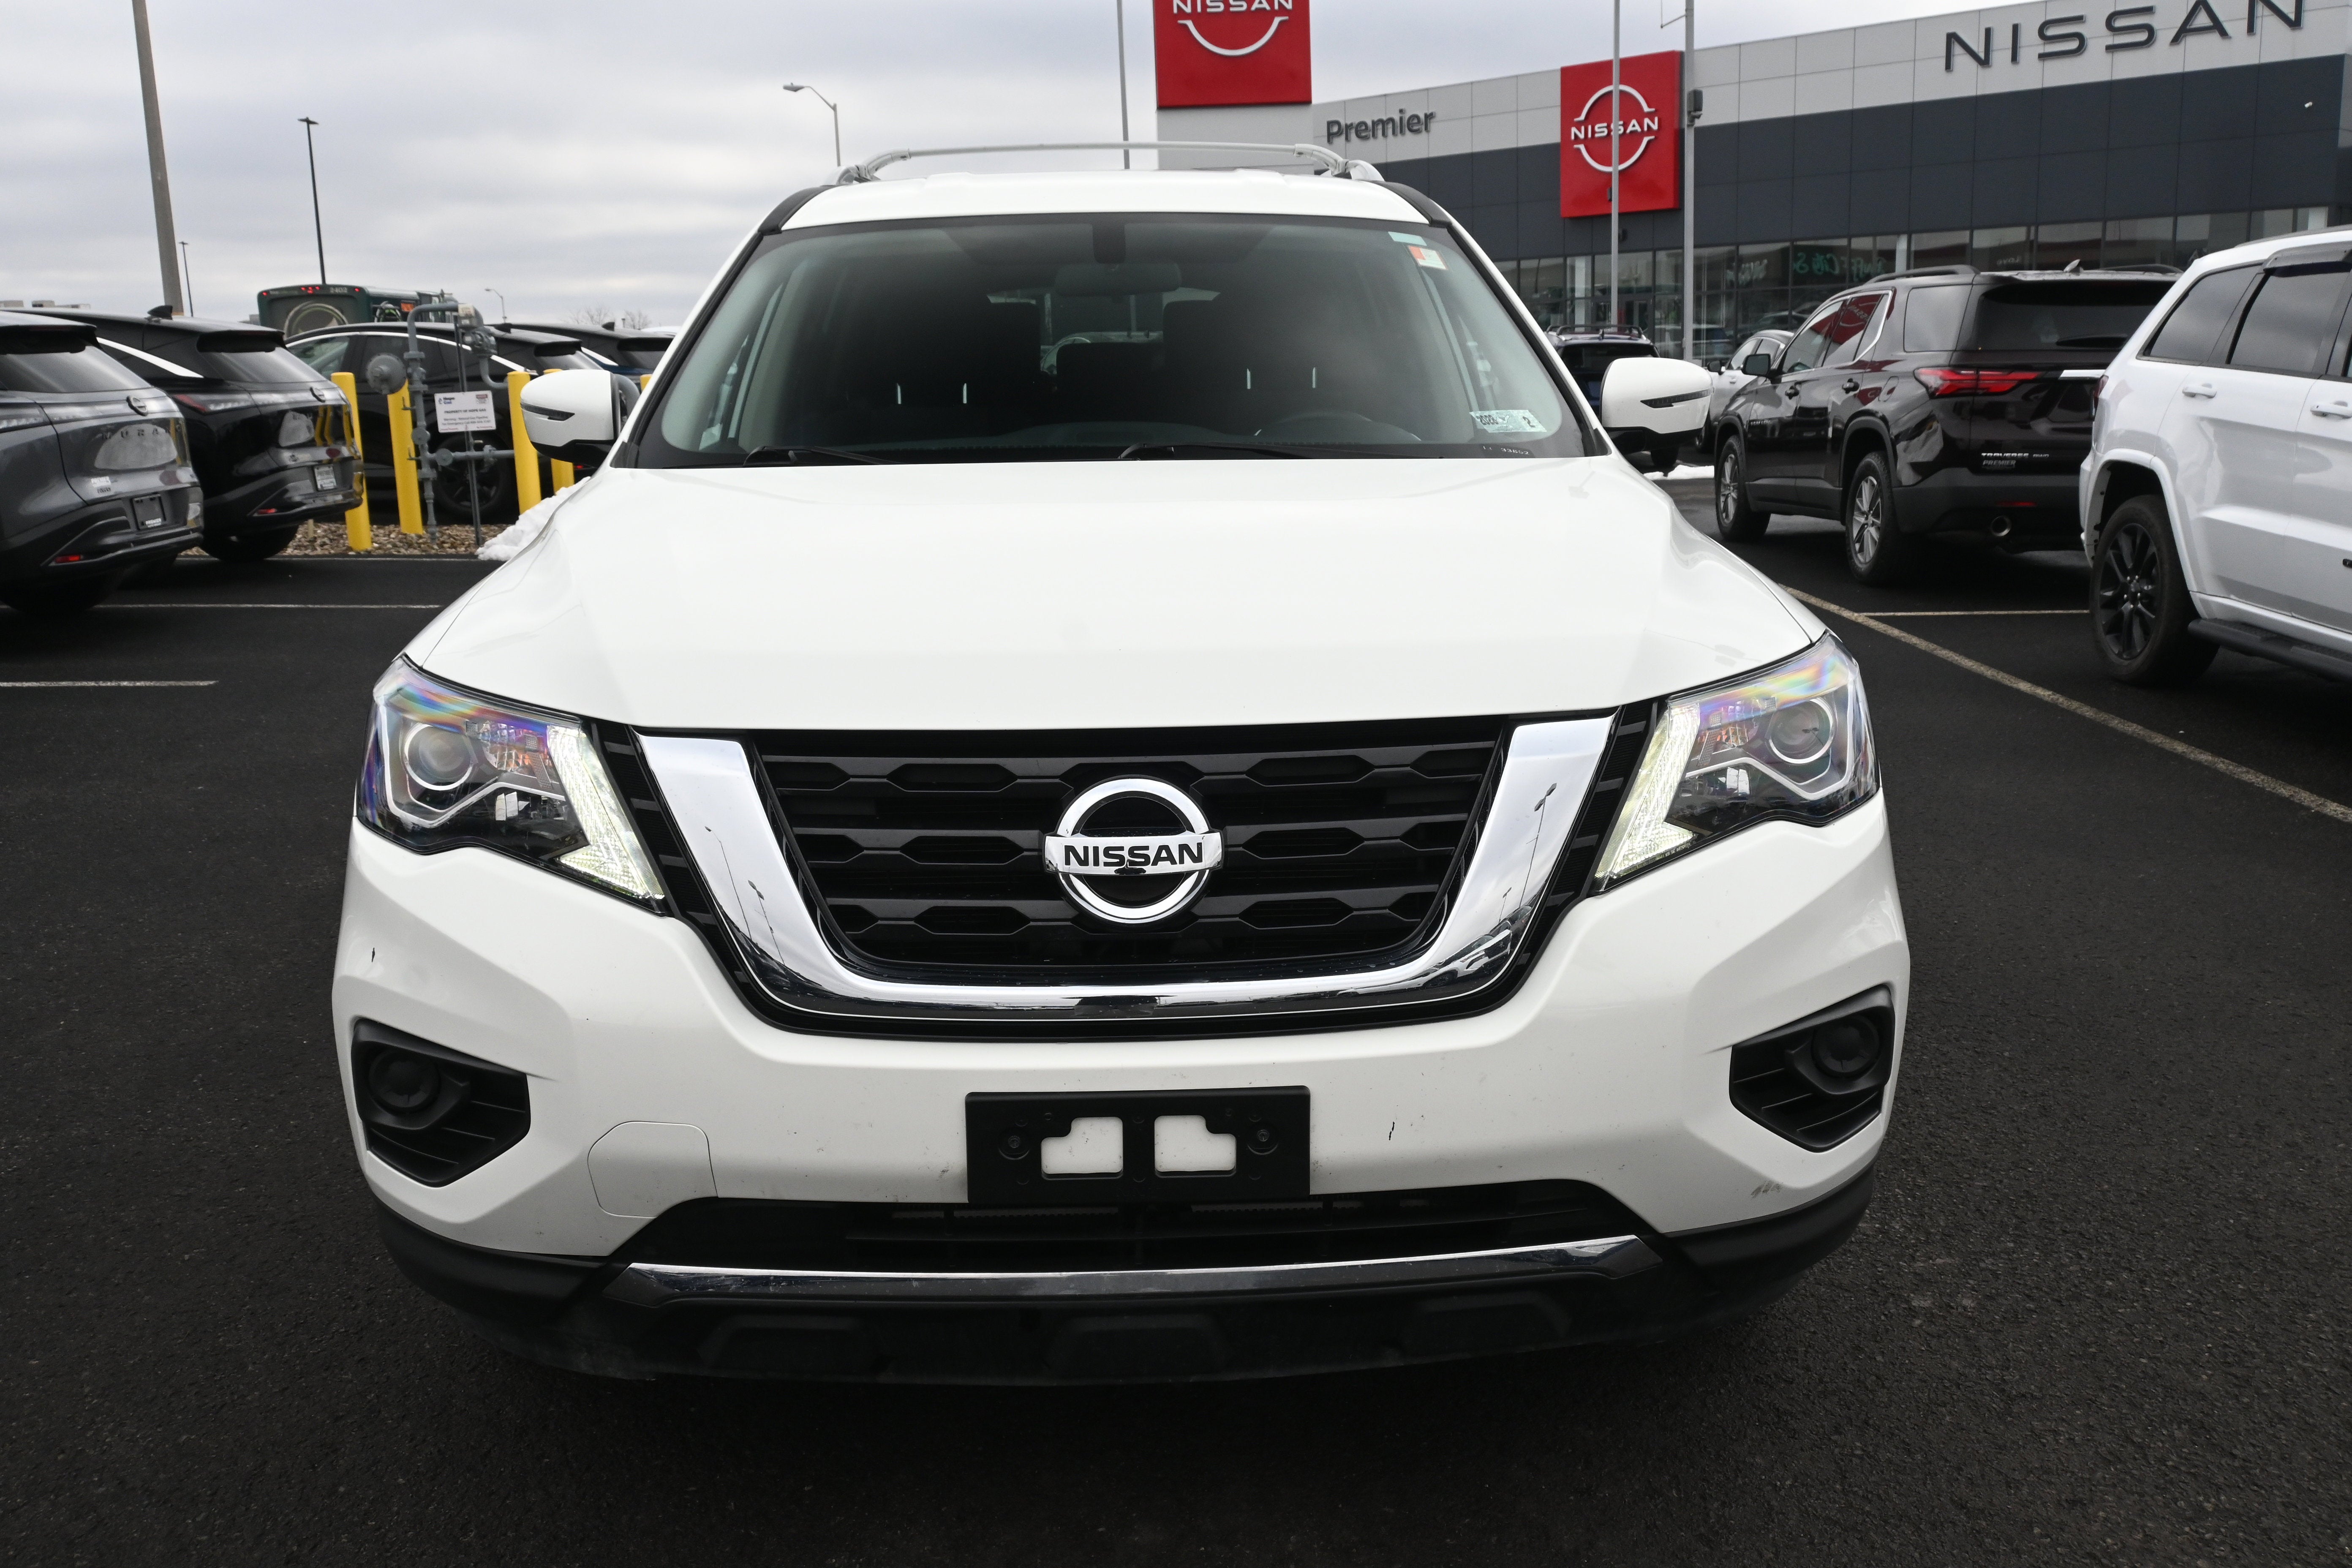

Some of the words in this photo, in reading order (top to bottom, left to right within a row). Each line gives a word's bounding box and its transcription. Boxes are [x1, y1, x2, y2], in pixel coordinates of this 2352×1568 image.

[1173, 0, 1293, 14] NISSAN
[1945, 0, 2304, 71] NISSAN
[1327, 108, 1436, 144] Premier
[1571, 116, 1658, 140] NISSAN
[1064, 842, 1203, 867] NISSAN
